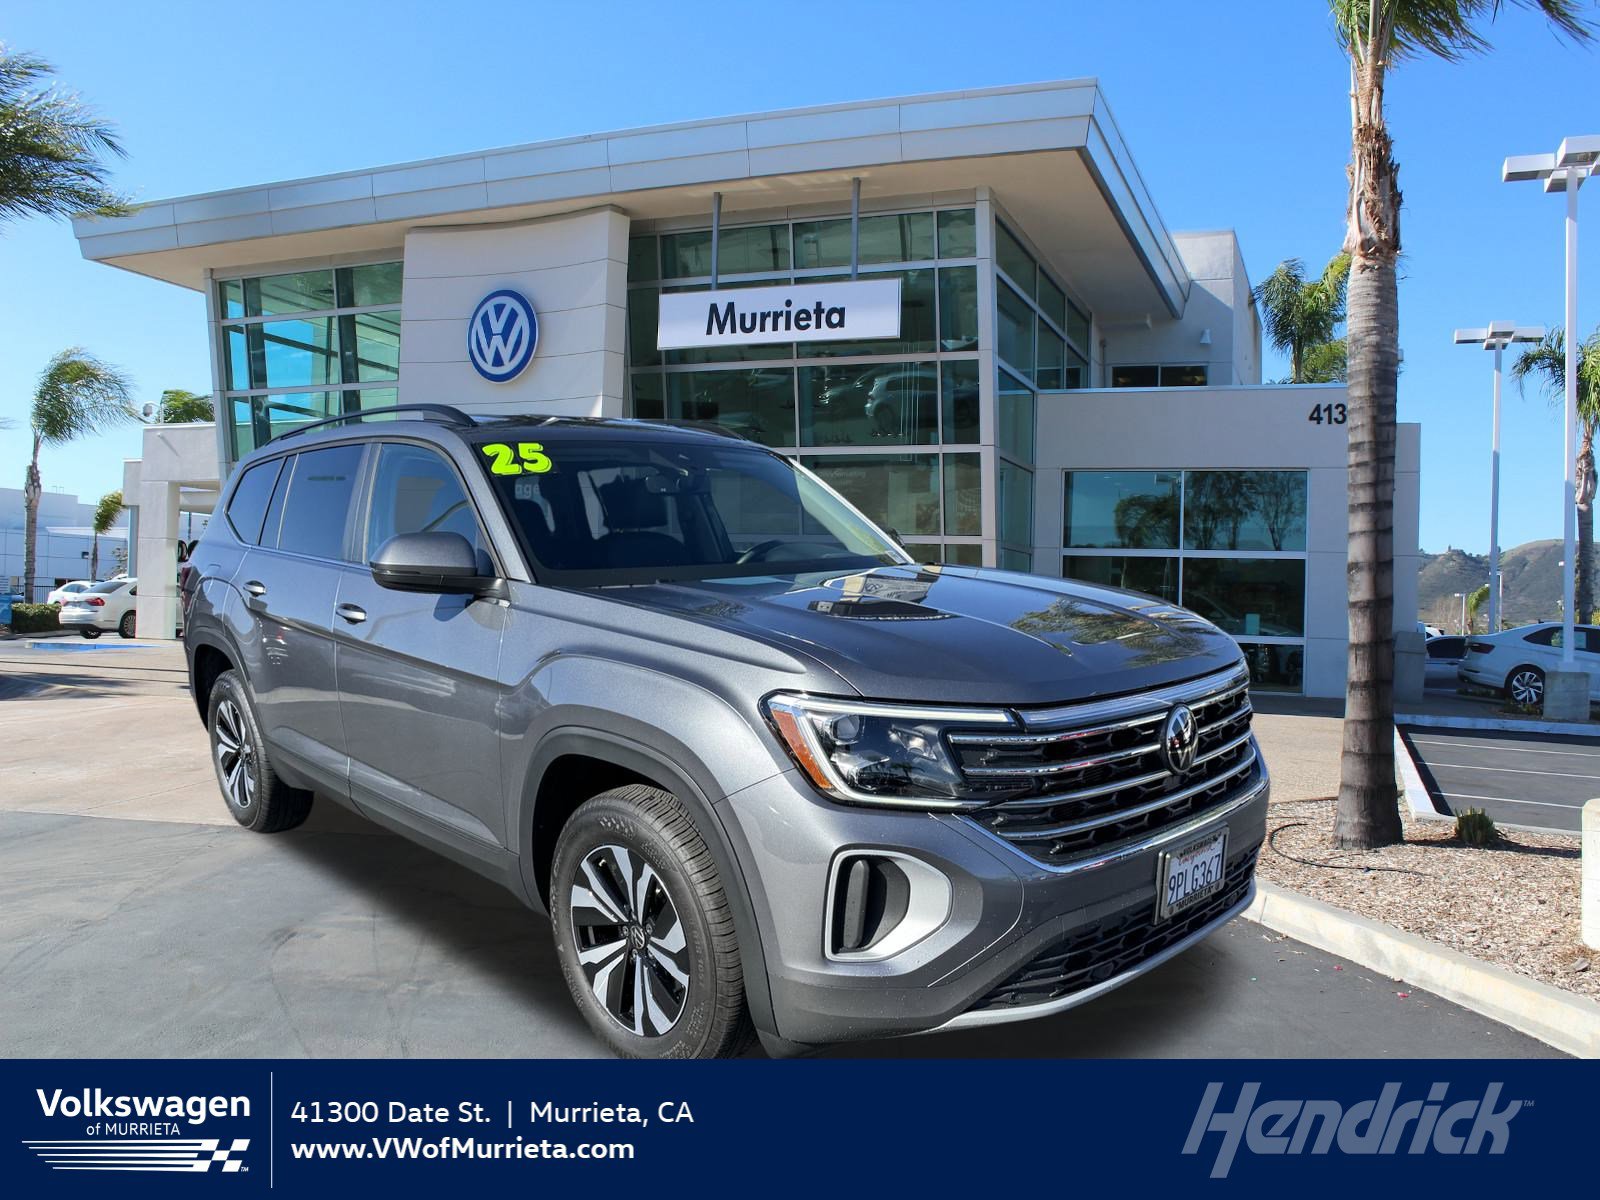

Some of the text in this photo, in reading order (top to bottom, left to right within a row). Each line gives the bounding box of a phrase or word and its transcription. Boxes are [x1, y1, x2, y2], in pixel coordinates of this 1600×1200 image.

[706, 299, 846, 336] Murrieta
[1308, 403, 1347, 425] 413
[481, 442, 552, 476] 25
[1168, 853, 1221, 907] 9PLG367
